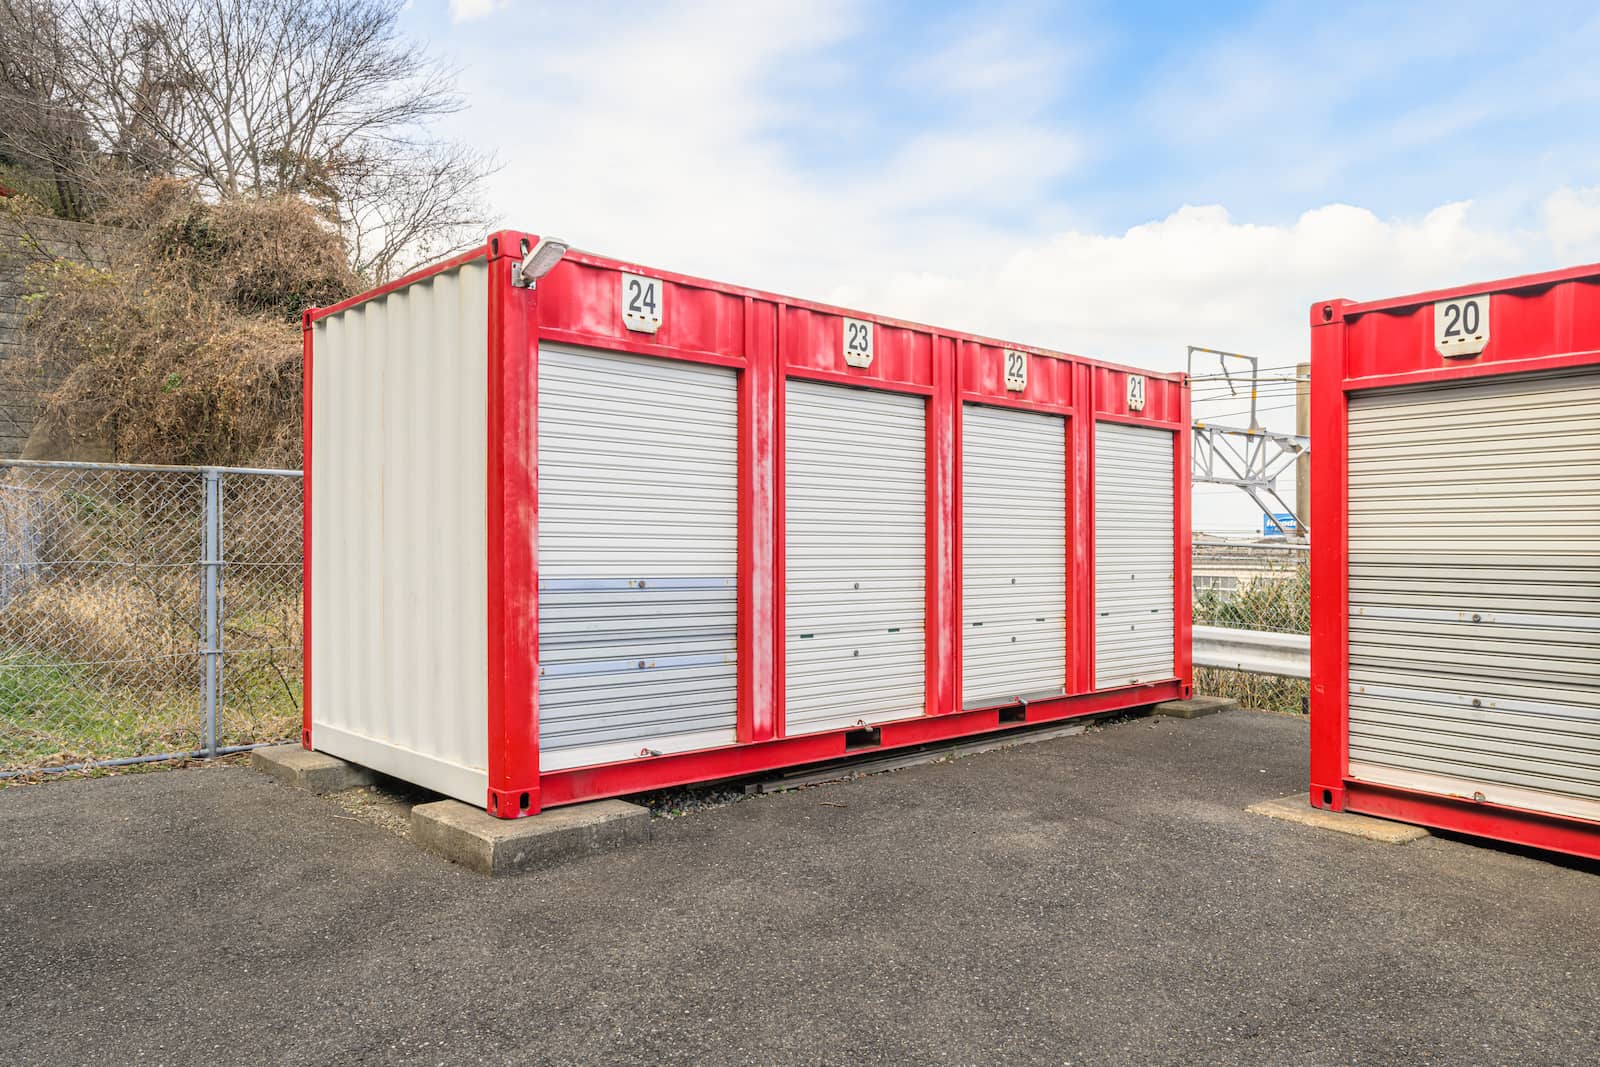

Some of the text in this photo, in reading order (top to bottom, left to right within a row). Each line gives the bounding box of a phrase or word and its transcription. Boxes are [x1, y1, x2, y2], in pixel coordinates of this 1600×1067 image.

[629, 280, 656, 314] 24
[1444, 301, 1479, 337] 20
[849, 323, 868, 352] 23
[1008, 352, 1024, 378] 22
[1130, 377, 1142, 399] 21
